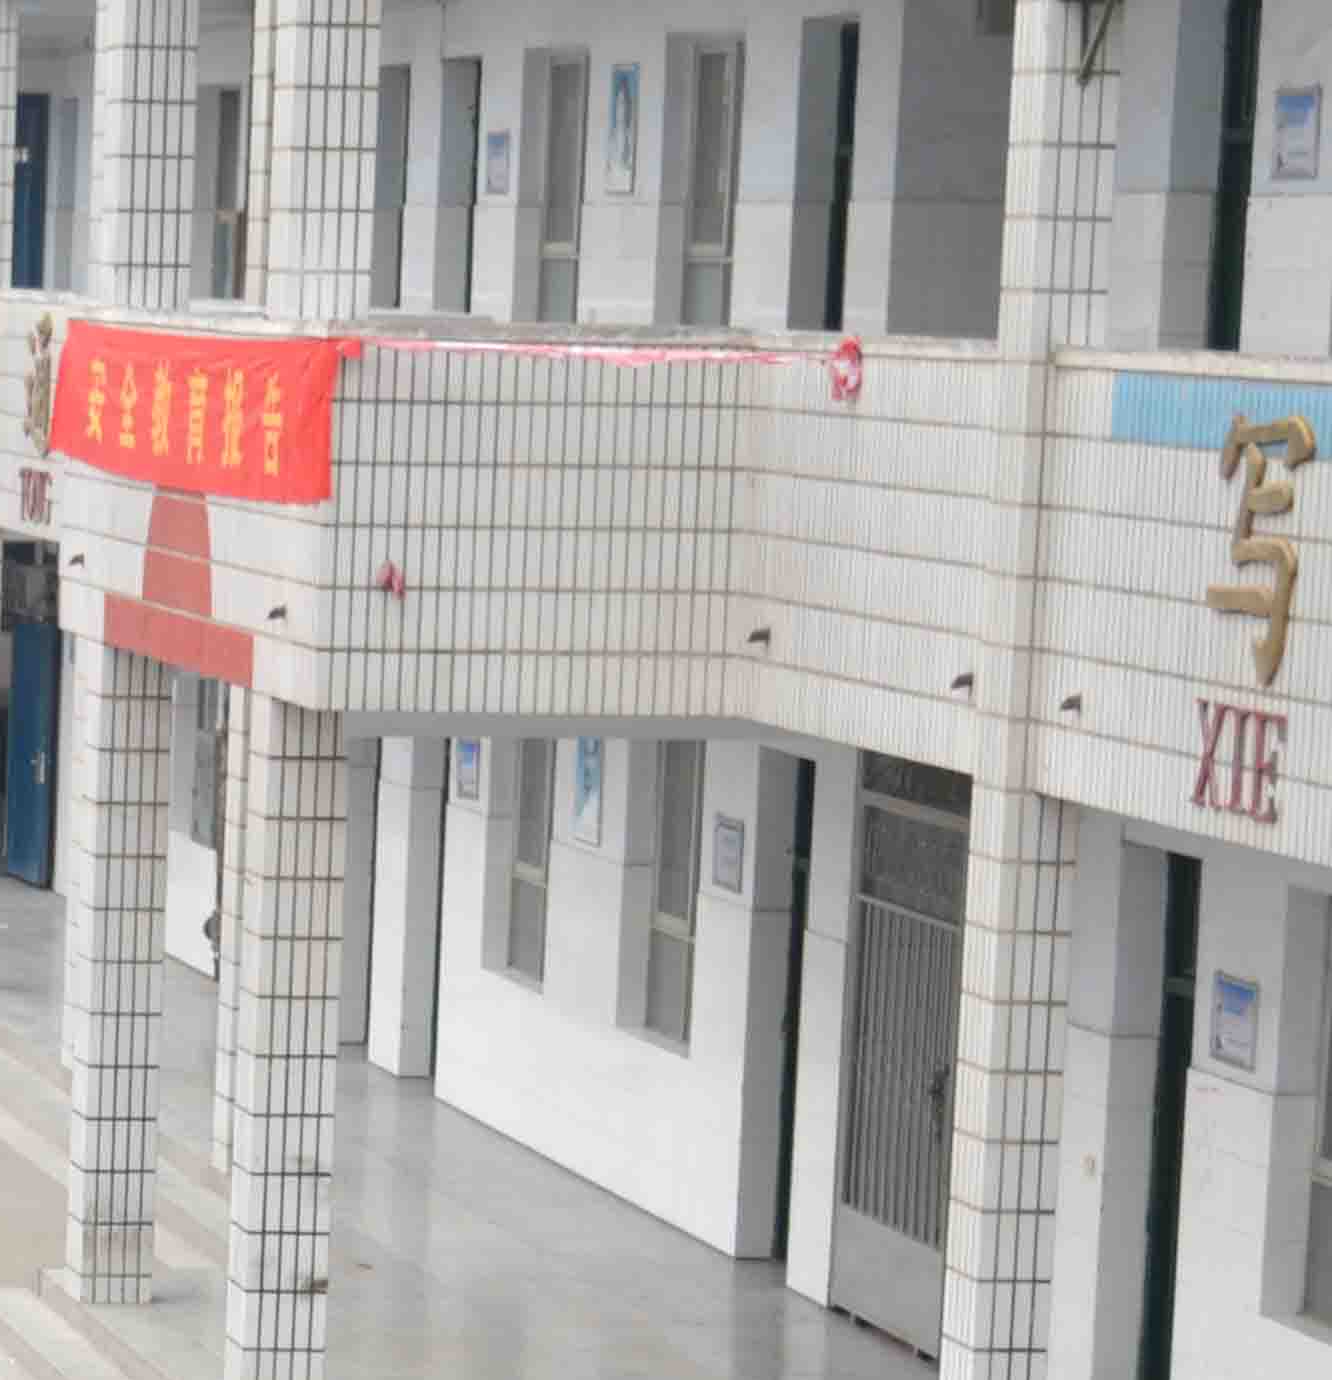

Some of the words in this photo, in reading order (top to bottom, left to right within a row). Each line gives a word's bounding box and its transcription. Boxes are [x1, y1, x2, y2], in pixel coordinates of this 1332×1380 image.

[86, 358, 282, 476] 安全教育报告
[1207, 413, 1317, 687] 写
[1191, 698, 1287, 825] XIE
